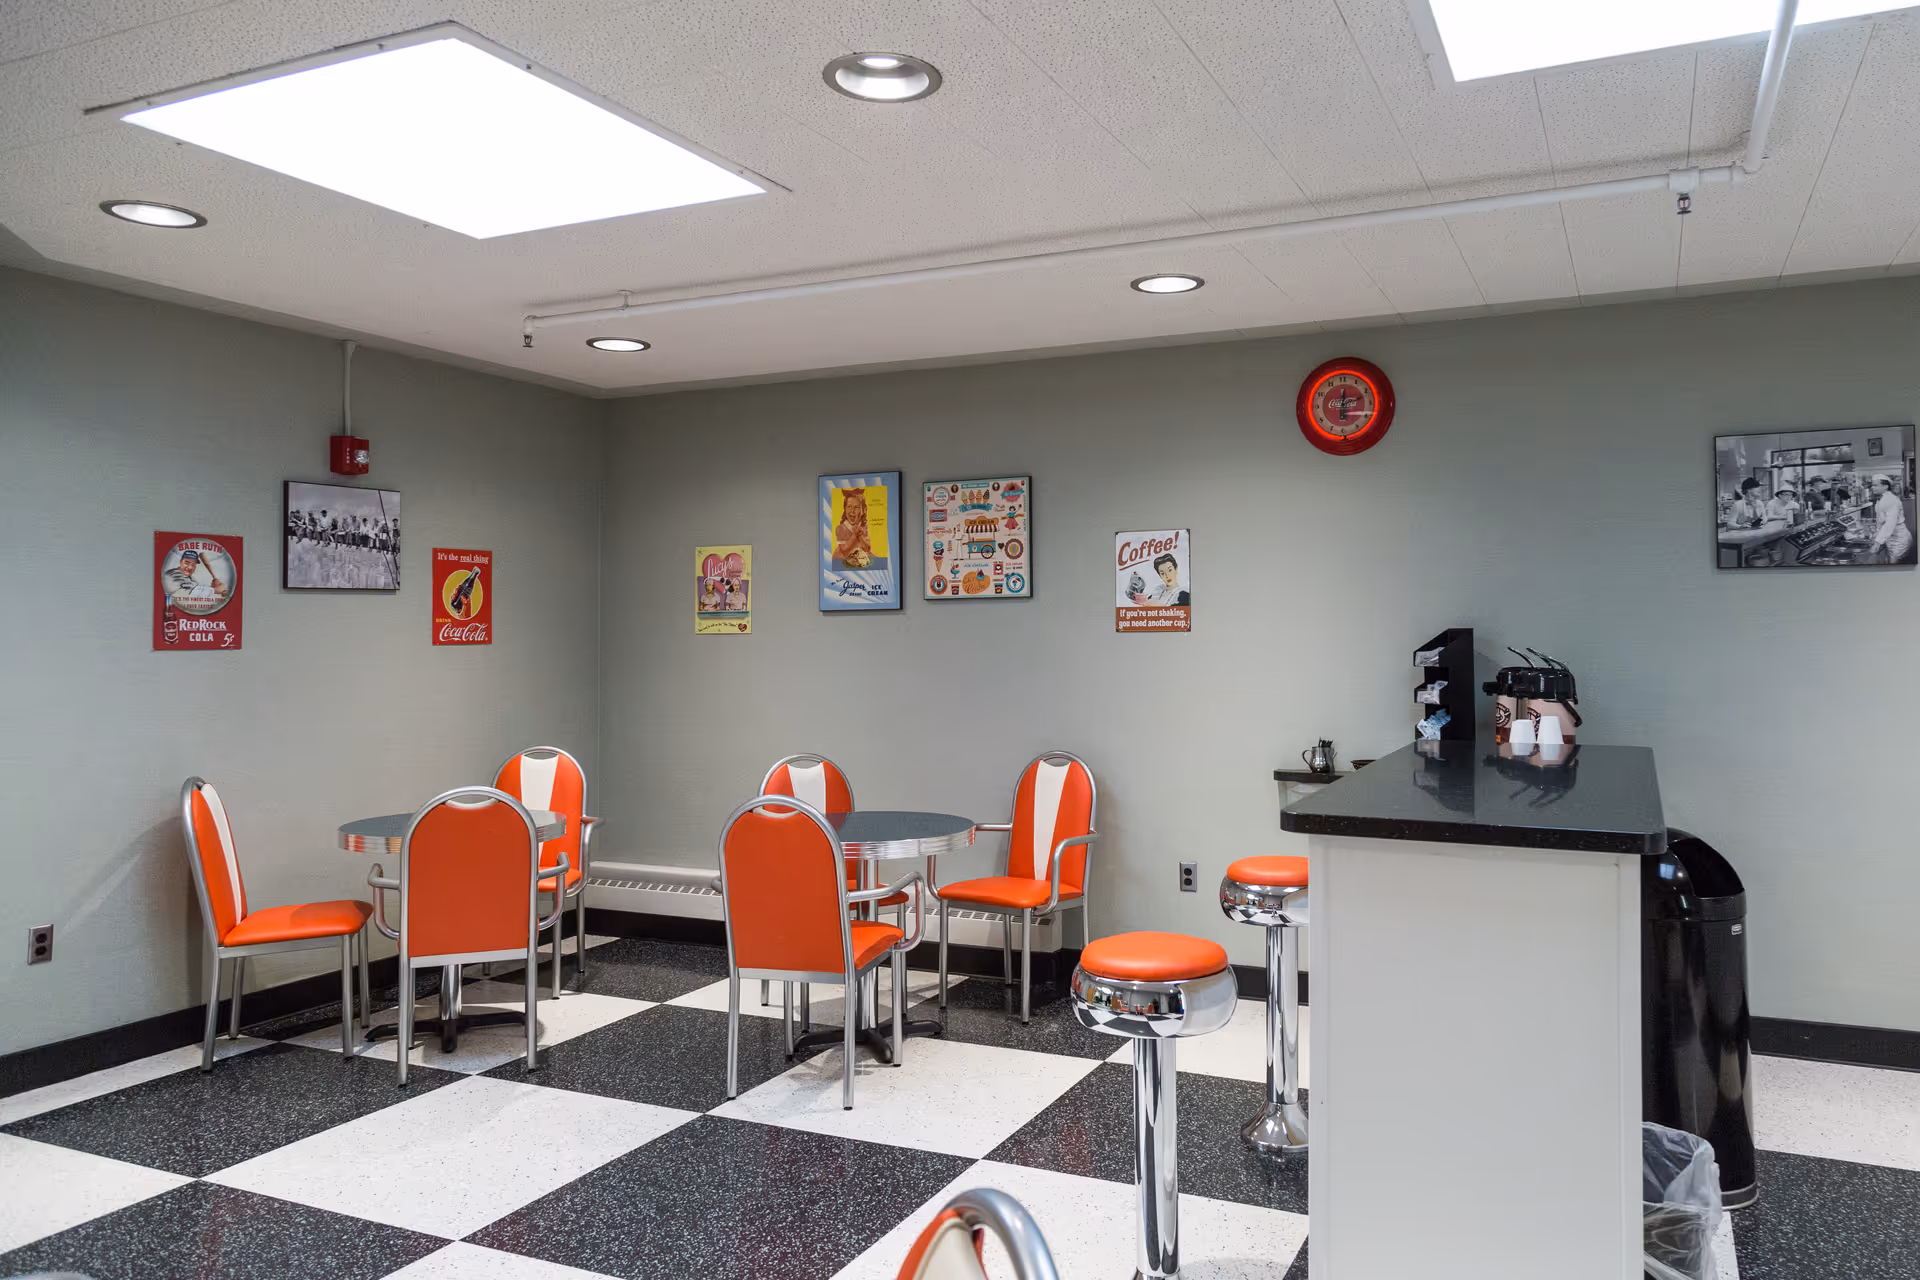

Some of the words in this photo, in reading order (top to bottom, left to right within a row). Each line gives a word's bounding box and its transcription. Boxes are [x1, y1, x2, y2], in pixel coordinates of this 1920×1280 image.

[179, 542, 200, 551] BABE
[202, 543, 222, 553] RUTH
[1118, 531, 1179, 566] Coffee!
[449, 553, 458, 561] the
[460, 554, 472, 562] real
[473, 555, 489, 564] thing
[1126, 609, 1147, 619] you're
[1131, 619, 1147, 627] need
[1147, 619, 1173, 627] another
[189, 632, 214, 642] COLA
